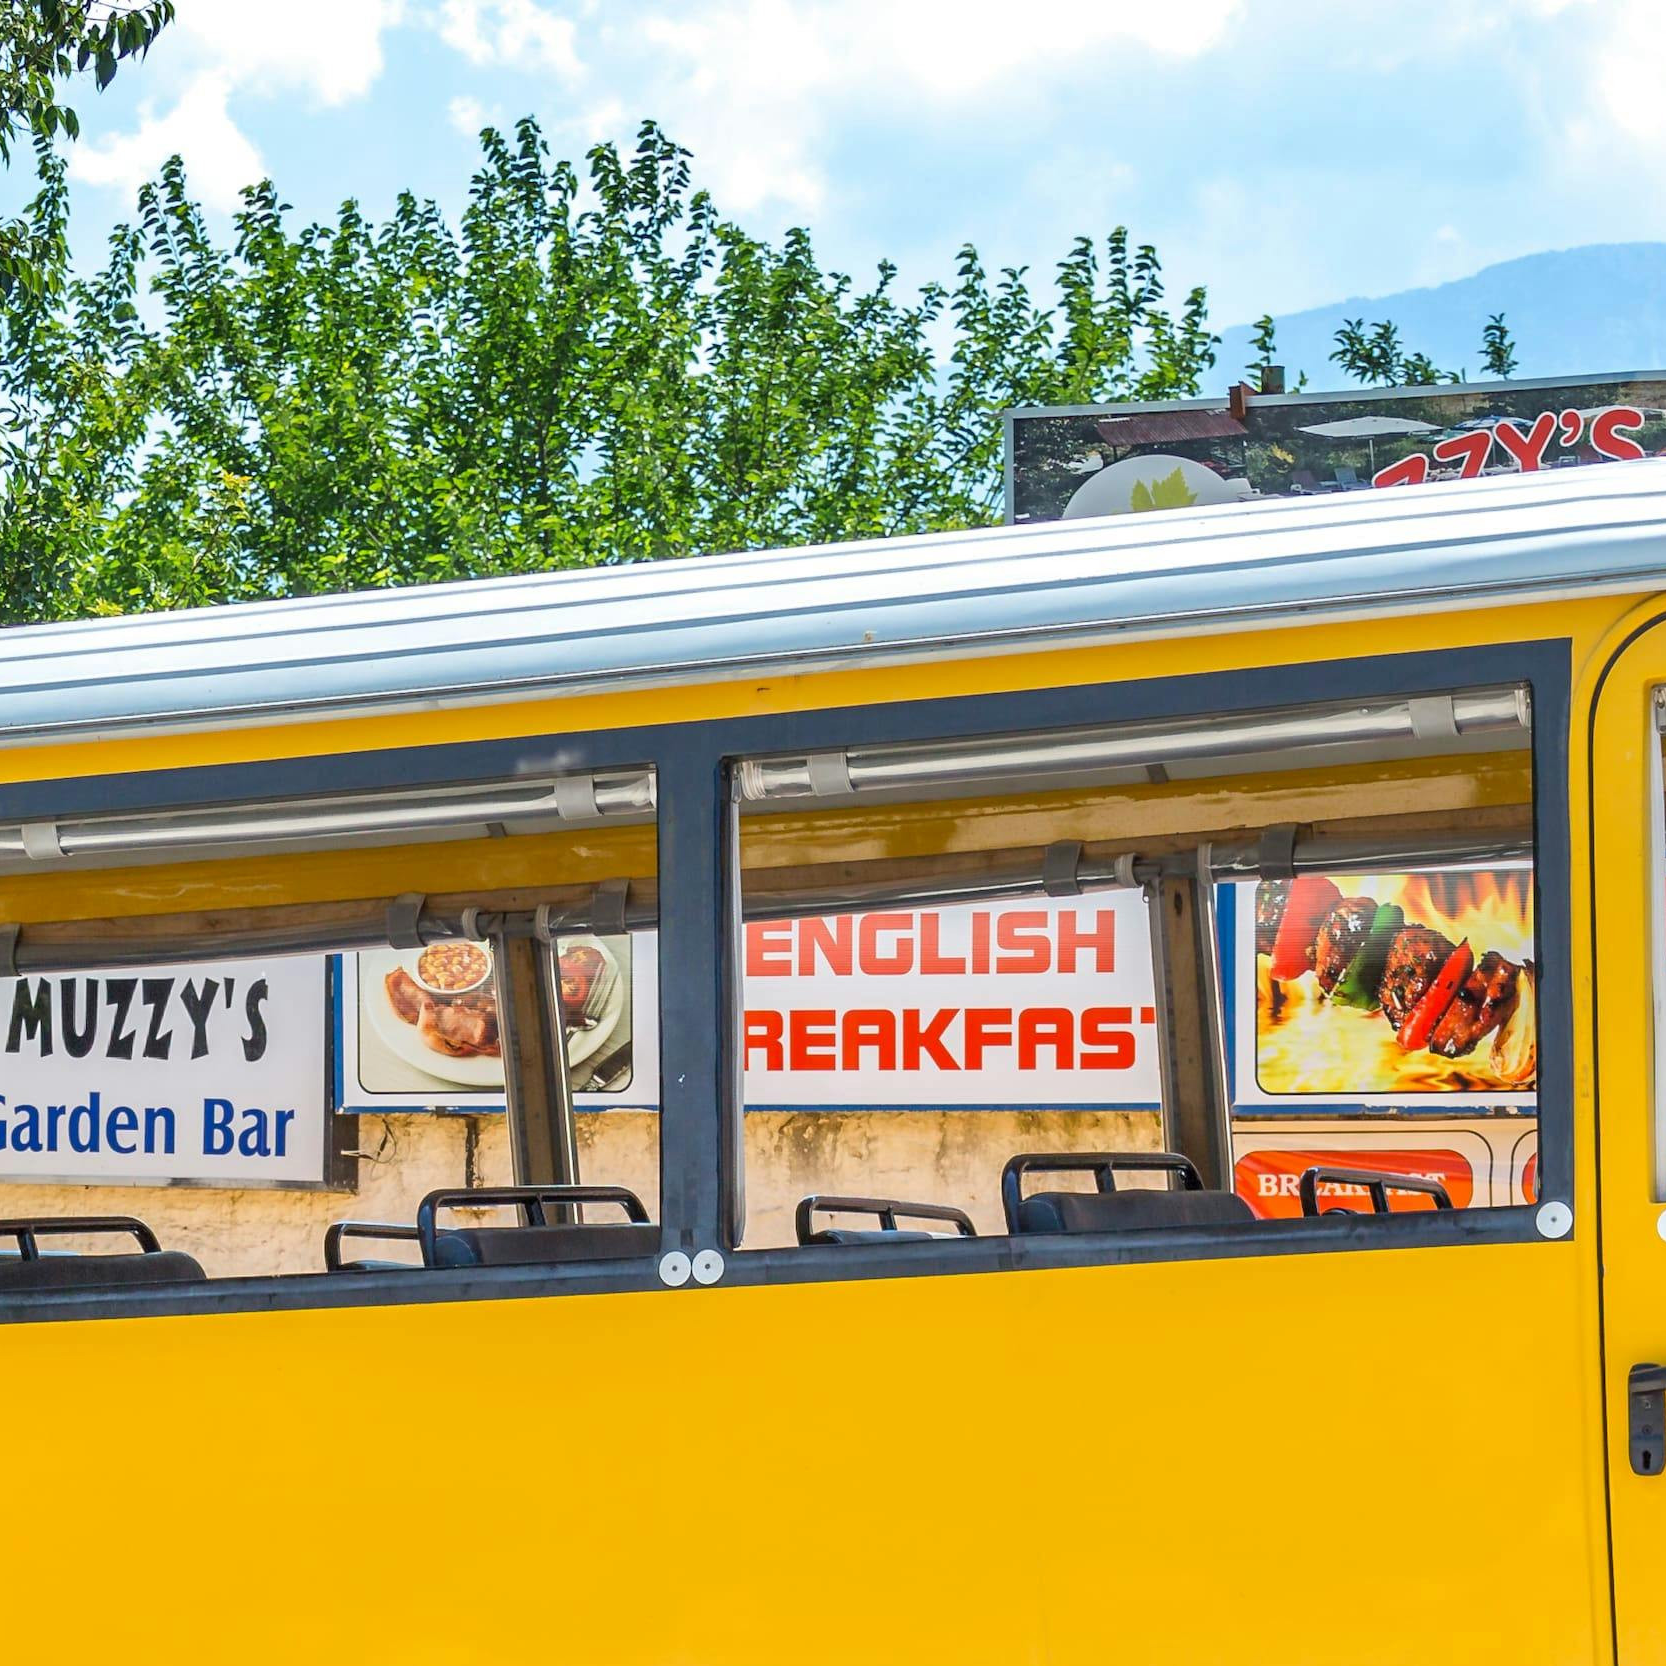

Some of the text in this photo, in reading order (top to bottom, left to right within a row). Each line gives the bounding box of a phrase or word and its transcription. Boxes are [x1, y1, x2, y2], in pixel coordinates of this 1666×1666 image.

[746, 909, 1115, 977] ENGLISH
[5, 975, 269, 1062] MUZZY'S
[743, 1006, 1157, 1072] REAKFAS
[202, 1096, 296, 1158] Bar
